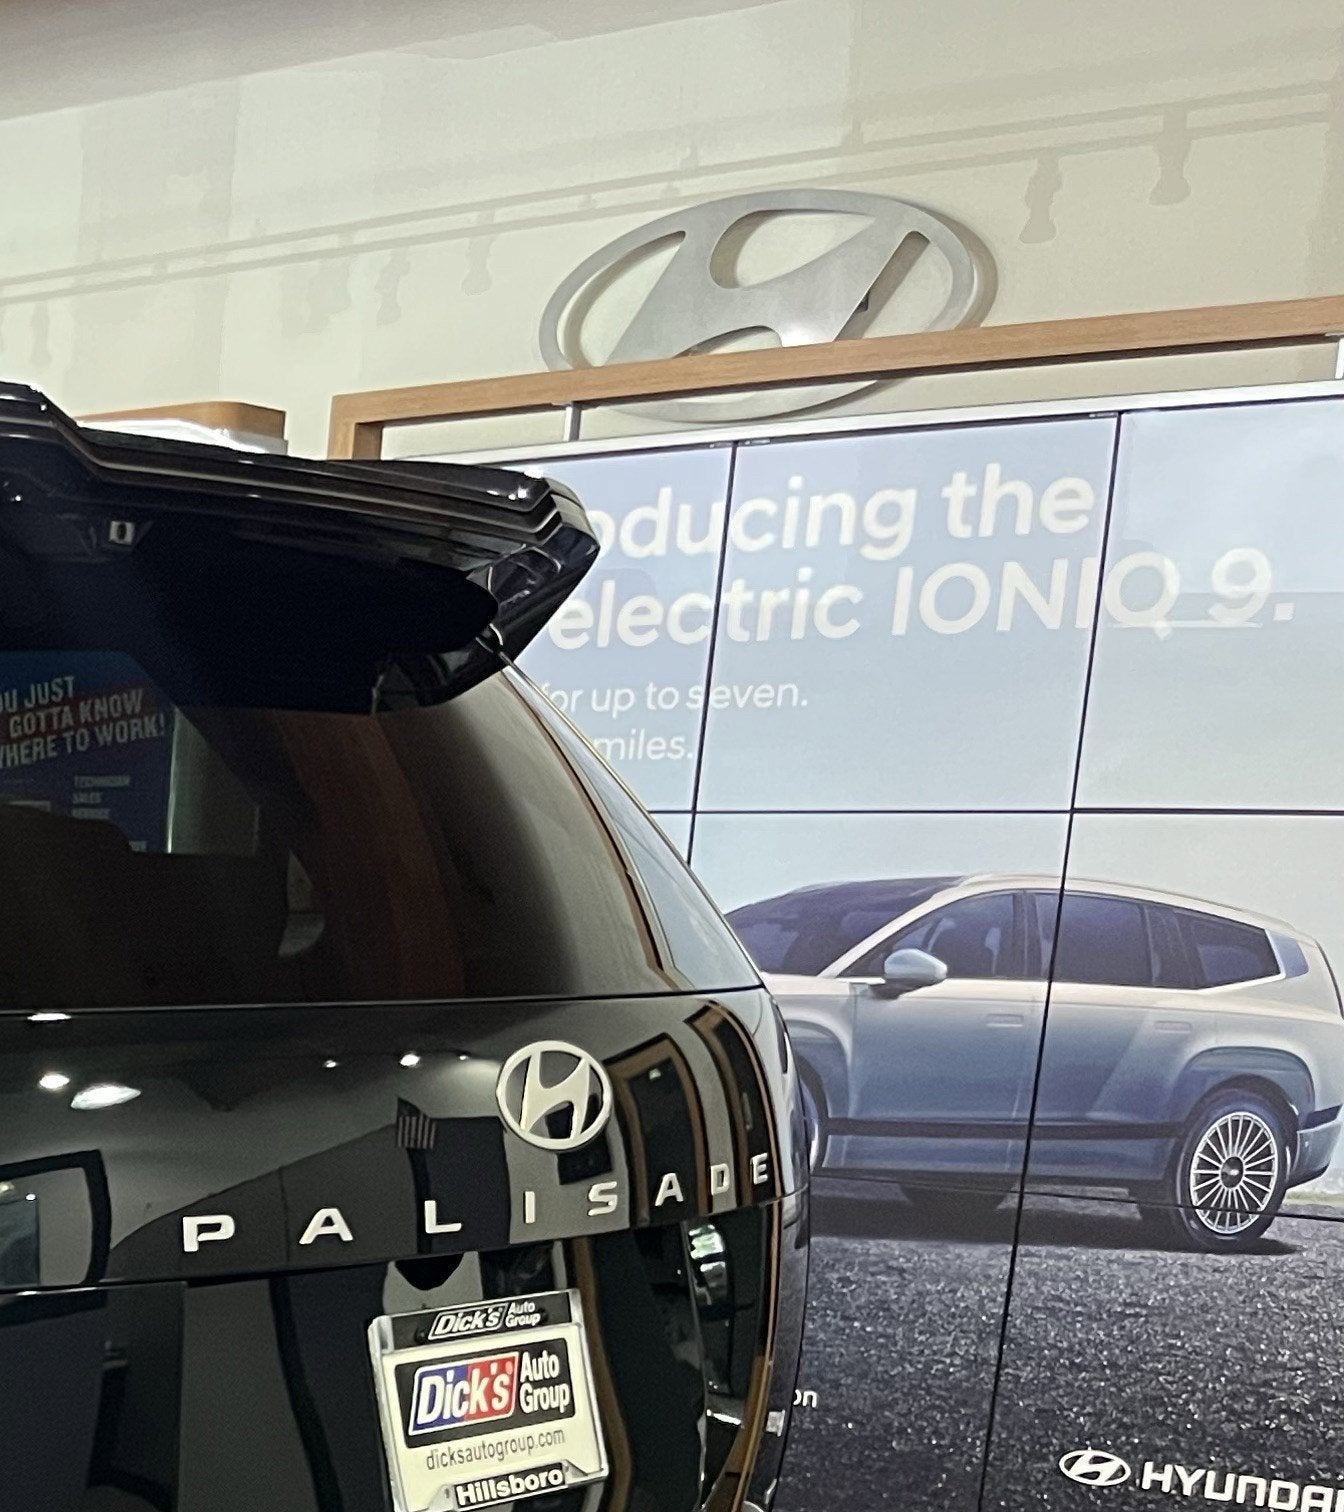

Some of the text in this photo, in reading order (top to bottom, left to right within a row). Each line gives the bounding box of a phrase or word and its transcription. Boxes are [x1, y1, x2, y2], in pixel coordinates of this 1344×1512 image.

[942, 463, 1095, 538] the
[549, 546, 1296, 650] electric IONIQ 9.
[23, 675, 75, 708] JUST
[591, 686, 635, 719] up
[646, 682, 680, 710] to
[685, 681, 809, 710] seven.
[9, 687, 144, 738] GOTTA KNOW
[63, 727, 90, 754] TO
[95, 713, 164, 746] WORK!
[182, 1152, 769, 1252] PALISADE
[433, 1306, 502, 1336] Dick's
[505, 1313, 541, 1329] Group
[508, 1301, 536, 1315] Auto
[519, 1349, 560, 1382] Auto
[416, 1361, 511, 1425] Dick's
[519, 1381, 570, 1414] Group
[426, 1428, 566, 1470] dicksautogroup.com
[455, 1468, 564, 1506] Hillsboro
